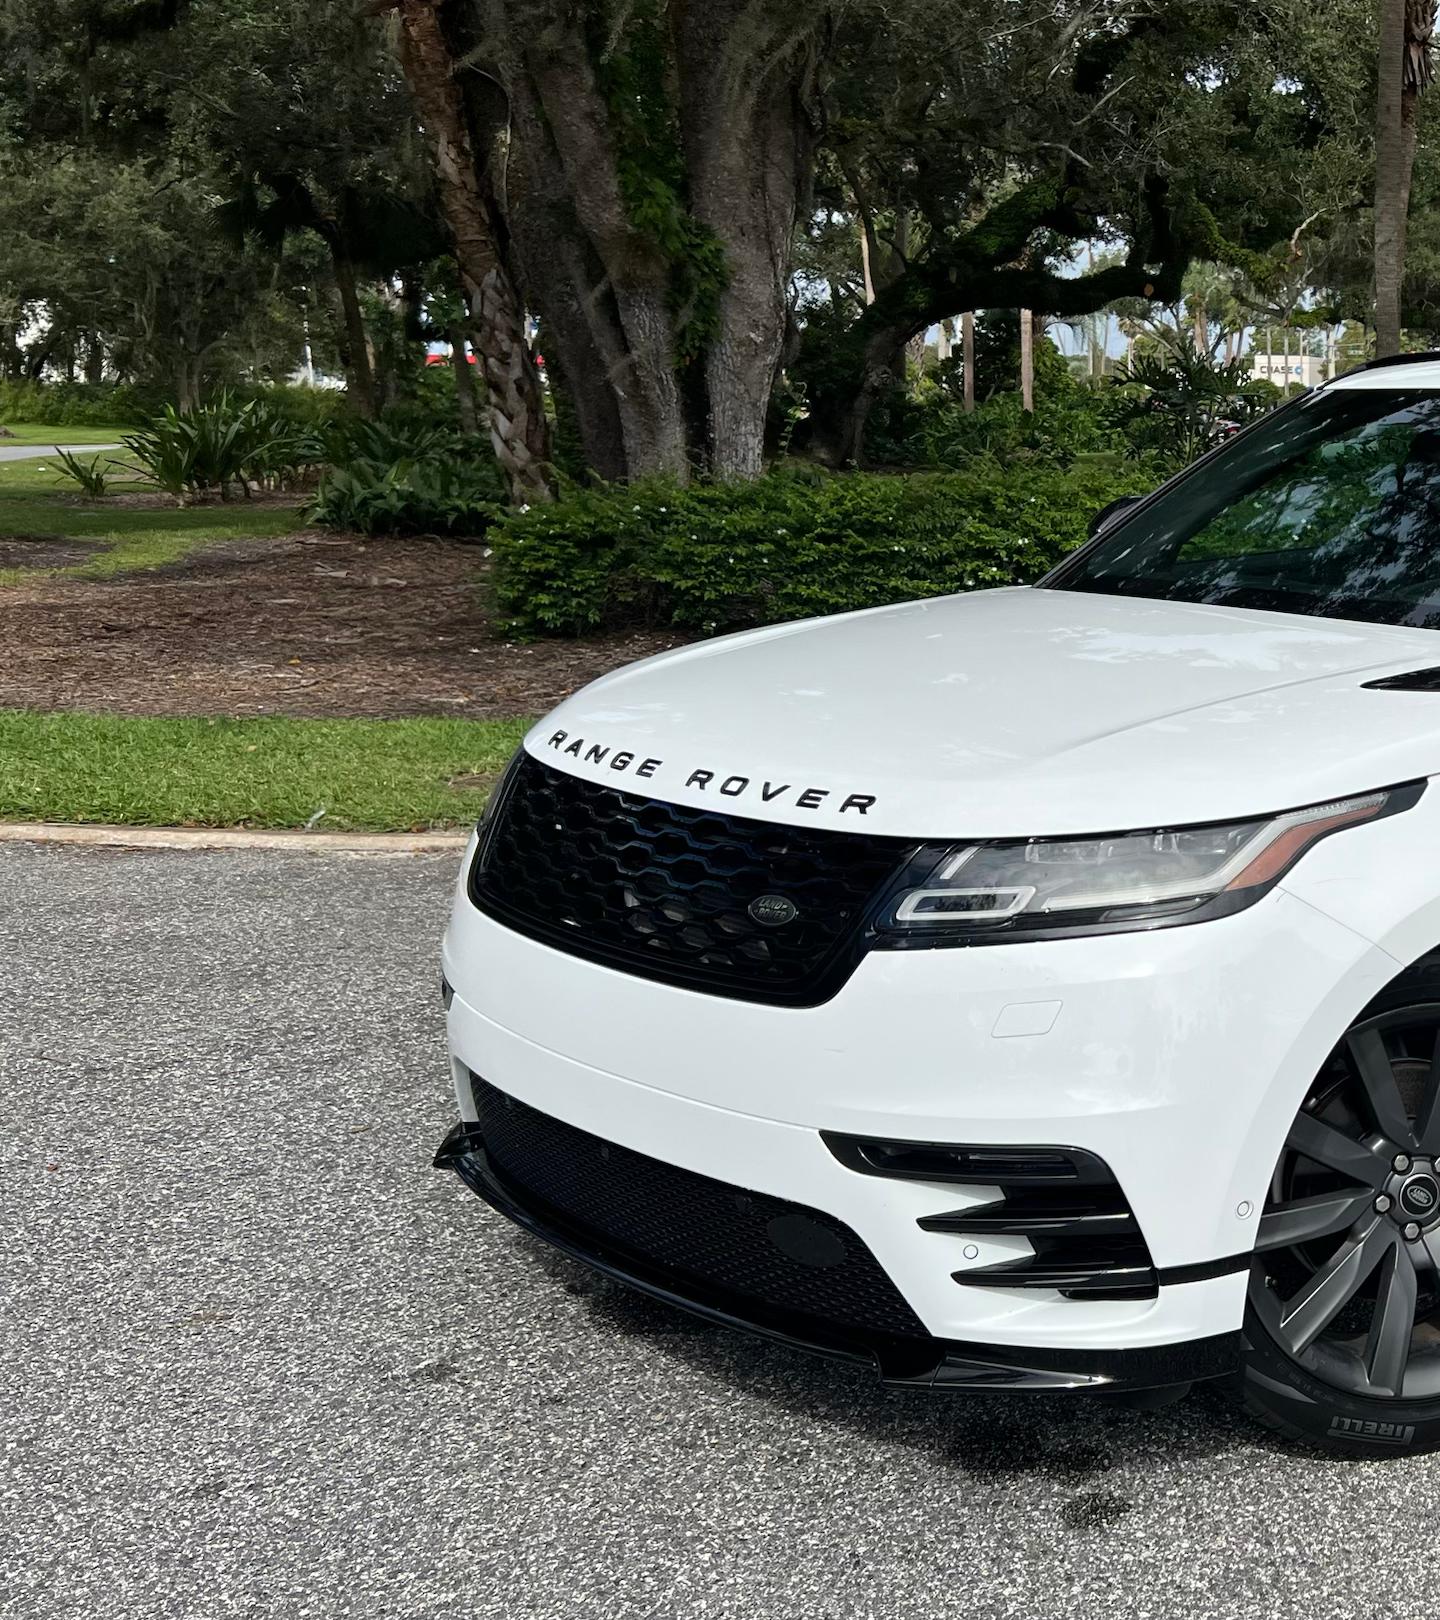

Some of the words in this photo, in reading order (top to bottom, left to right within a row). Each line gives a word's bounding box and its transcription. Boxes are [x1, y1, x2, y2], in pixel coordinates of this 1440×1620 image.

[547, 729, 663, 778] RANGE
[685, 769, 877, 815] ROVER
[1327, 1415, 1416, 1446] PIRELLI
